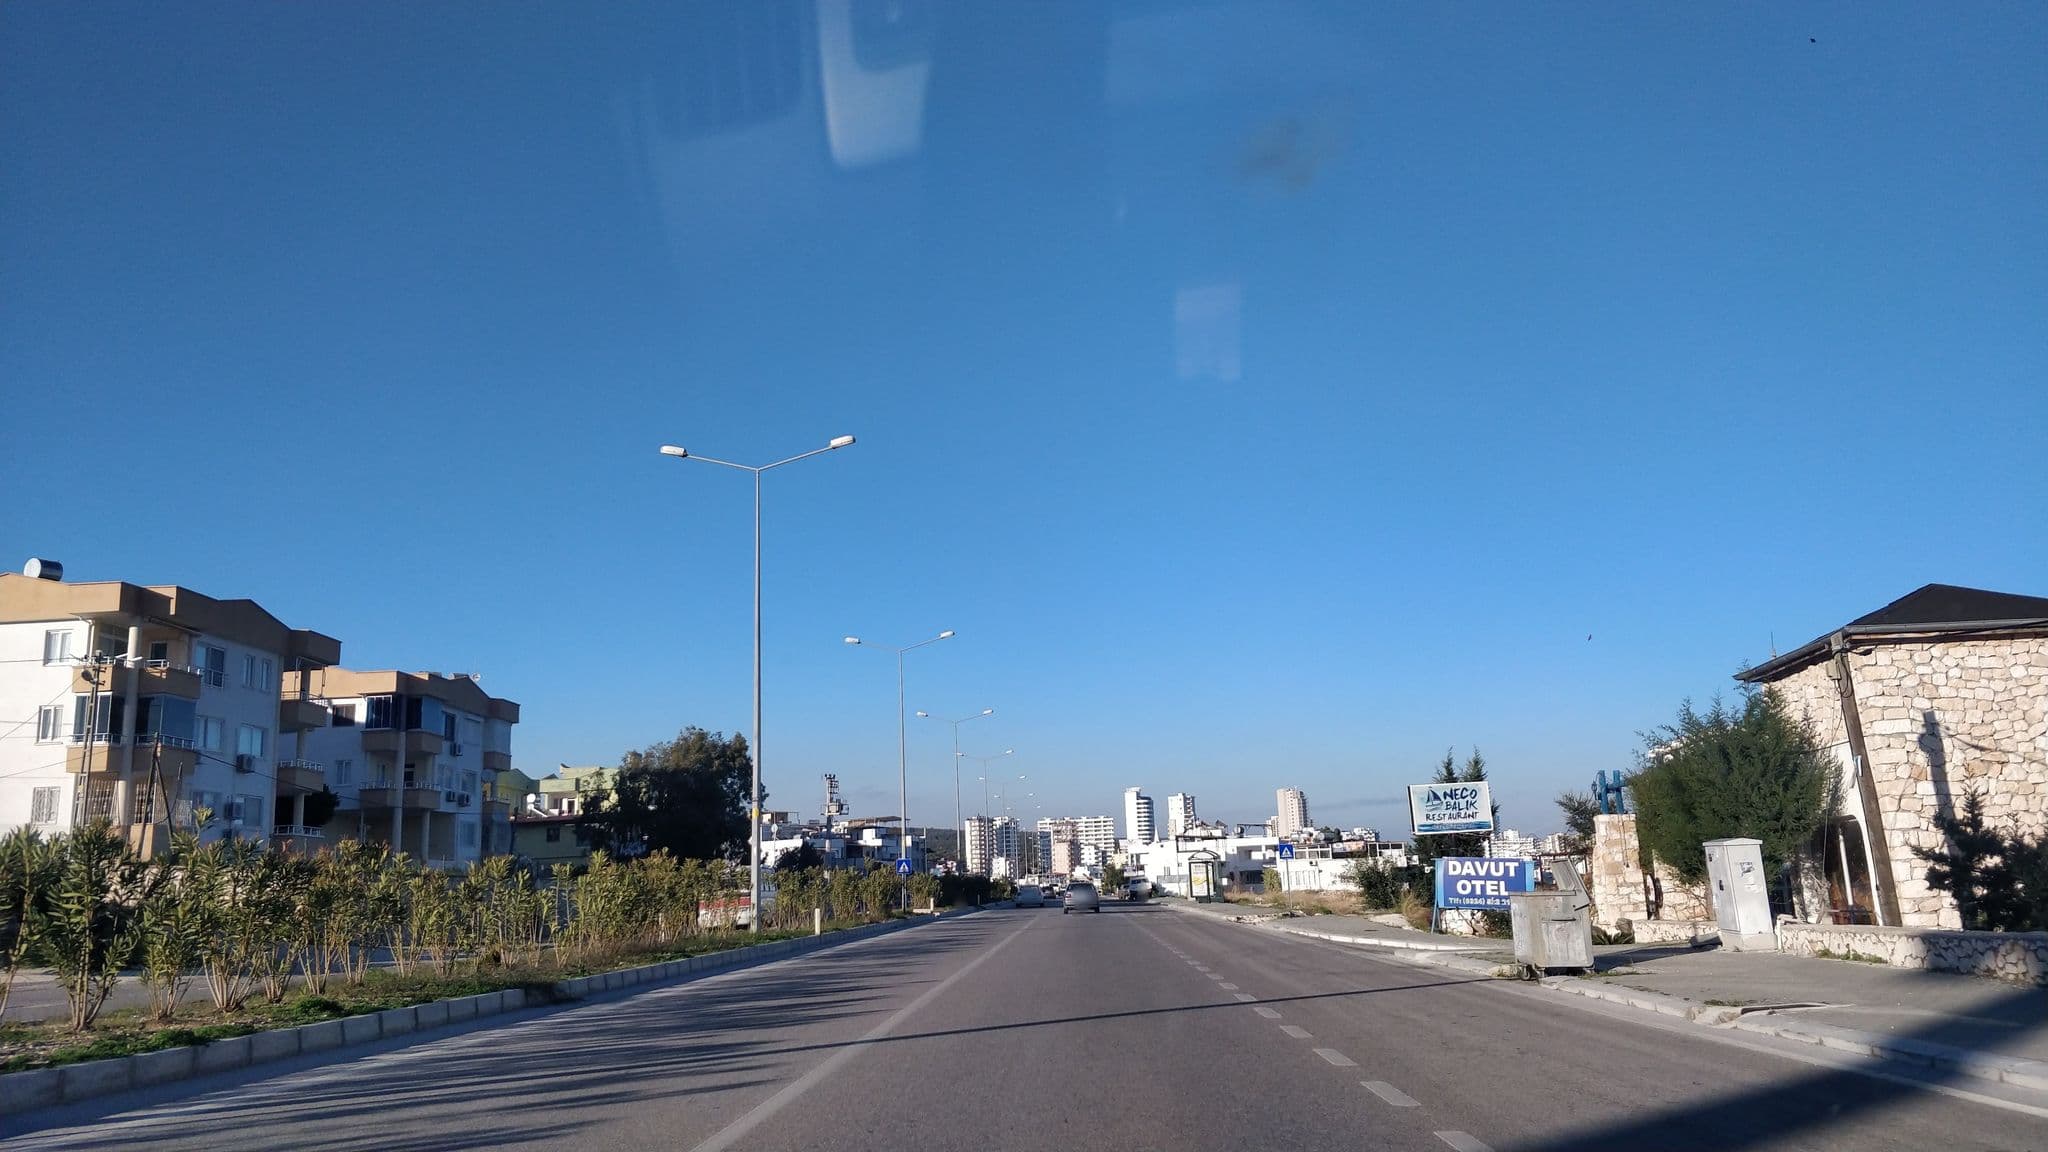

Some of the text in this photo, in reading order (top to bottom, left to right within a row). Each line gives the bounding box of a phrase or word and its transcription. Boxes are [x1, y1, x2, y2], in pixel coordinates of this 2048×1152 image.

[1443, 787, 1478, 801] NECO
[1446, 800, 1478, 811] BALIK
[1426, 811, 1479, 821] RESTAURANT
[1448, 861, 1519, 877] DAVUT
[1456, 880, 1509, 896] OTEL
